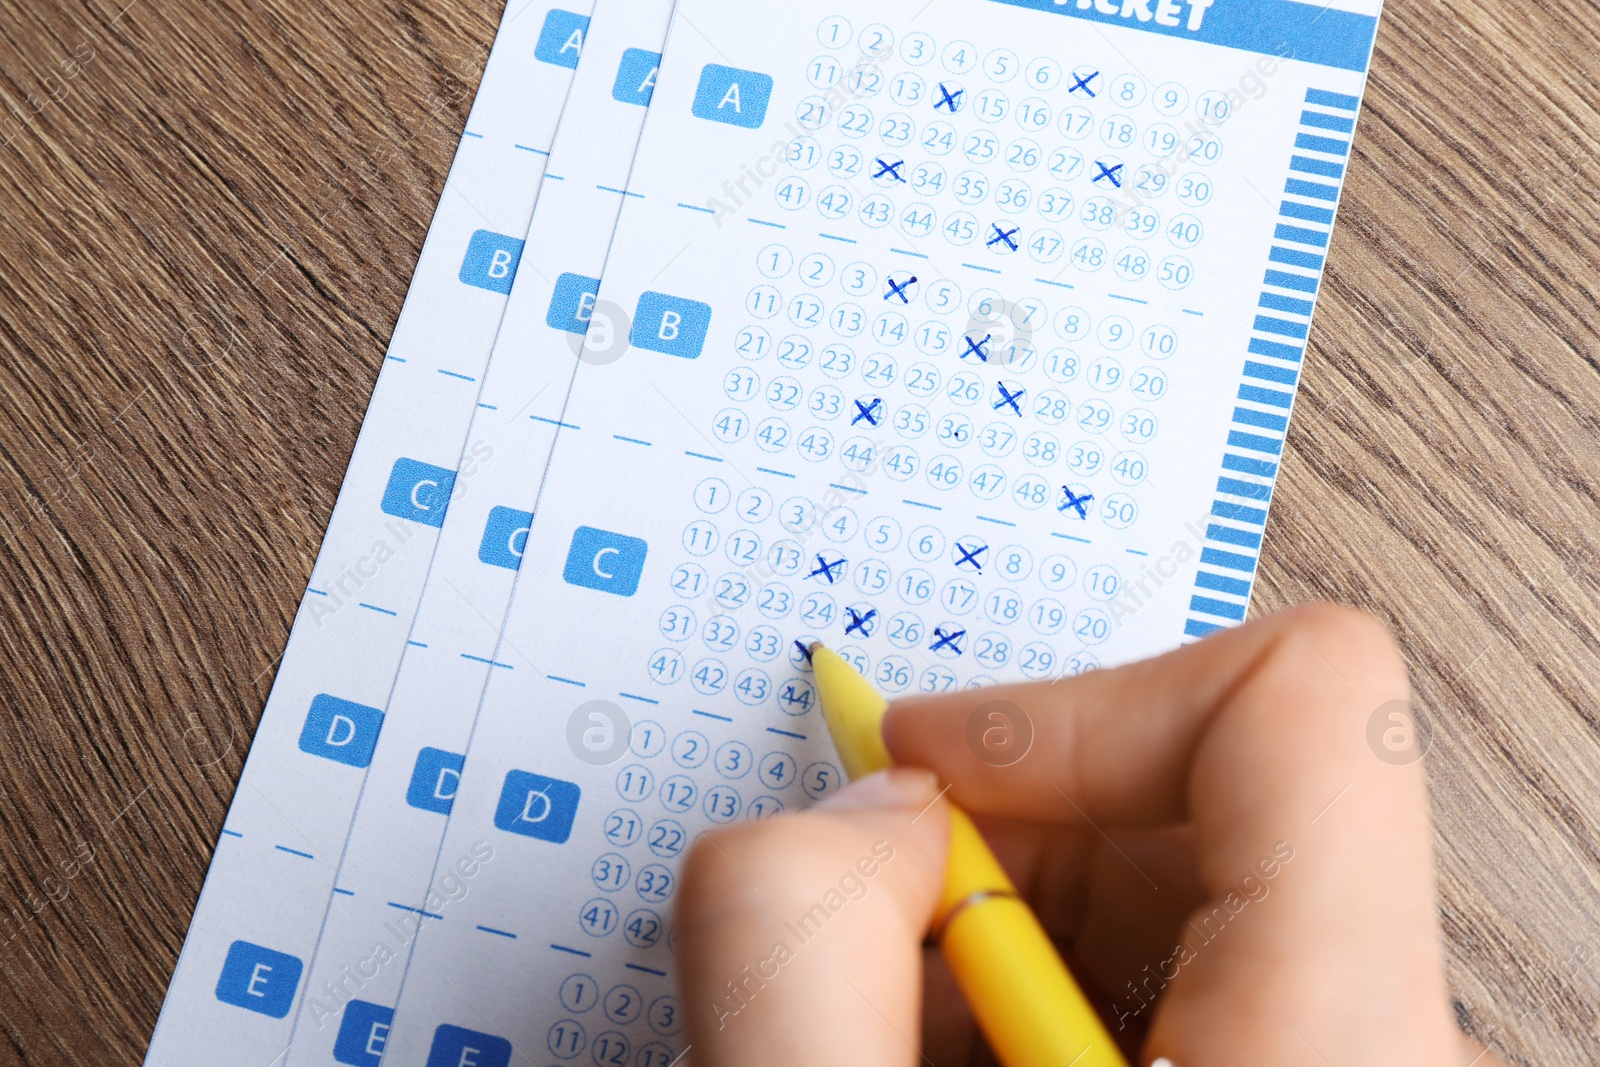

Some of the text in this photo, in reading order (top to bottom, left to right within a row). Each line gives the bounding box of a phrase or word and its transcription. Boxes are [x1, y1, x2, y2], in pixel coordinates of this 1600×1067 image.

[560, 29, 583, 56] A
[910, 39, 925, 60] 3
[951, 48, 966, 67] 4
[993, 55, 1009, 76] 5
[1120, 81, 1136, 101] 8
[1163, 89, 1179, 109] 9
[717, 83, 741, 113] A
[814, 62, 836, 84] 11
[897, 79, 921, 101] 13
[981, 95, 1006, 118] 15
[1023, 104, 1048, 127] 16
[1065, 112, 1091, 134] 17
[1107, 121, 1134, 144] 18
[882, 119, 911, 141] 23
[924, 127, 953, 149] 24
[966, 135, 996, 159] 25
[1009, 144, 1037, 167] 26
[1051, 153, 1081, 175] 27
[1180, 178, 1210, 202] 30
[831, 150, 860, 174] 32
[914, 167, 943, 191] 34
[957, 176, 986, 199] 35
[998, 185, 1028, 208] 36
[1041, 193, 1071, 216] 37
[1169, 221, 1200, 243] 40
[777, 183, 804, 205] 41
[820, 192, 849, 215] 42
[861, 201, 891, 223] 43
[903, 210, 933, 231] 44
[945, 218, 976, 240] 45
[1031, 235, 1061, 257] 47
[1073, 244, 1104, 267] 48
[1116, 254, 1147, 276] 48
[1161, 261, 1191, 285] 50
[487, 249, 512, 278] B
[575, 291, 597, 322] B
[657, 310, 681, 341] B
[808, 260, 825, 281] 2
[850, 269, 866, 290] 3
[936, 287, 951, 307] 5
[1063, 314, 1081, 335] 8
[1149, 331, 1175, 354] 10
[753, 291, 776, 313] 11
[795, 300, 821, 323] 12
[837, 309, 862, 332] 13
[880, 318, 905, 342] 14
[923, 327, 948, 350] 15
[1051, 354, 1077, 378] 18
[1134, 372, 1165, 396] 20
[738, 331, 765, 355] 21
[780, 341, 810, 365] 22
[823, 349, 852, 373] 23
[865, 359, 894, 382] 24
[908, 368, 937, 392] 25
[950, 377, 979, 401] 26
[1037, 395, 1067, 420] 28
[1080, 405, 1111, 428] 29
[1126, 414, 1155, 439] 30
[727, 372, 754, 396] 31
[769, 381, 799, 407] 32
[812, 391, 841, 415] 33
[897, 409, 927, 433] 35
[983, 429, 1014, 451] 37
[1027, 437, 1057, 462] 38
[1113, 458, 1145, 481] 40
[716, 415, 743, 437] 41
[758, 424, 788, 448] 42
[800, 433, 830, 457] 43
[929, 462, 959, 485] 46
[972, 471, 1004, 493] 47
[1015, 481, 1047, 504] 48
[1103, 499, 1135, 523] 50
[410, 479, 437, 511] C
[592, 547, 620, 579] C
[746, 495, 763, 517] 2
[832, 515, 847, 536] 4
[874, 524, 891, 545] 5
[918, 535, 934, 555] 6
[1005, 553, 1022, 575] 8
[1092, 571, 1118, 596] 10
[690, 527, 713, 551] 11
[733, 536, 759, 561] 12
[862, 566, 887, 590] 15
[905, 575, 931, 600] 16
[993, 595, 1019, 620] 18
[1077, 615, 1108, 639] 20
[674, 568, 702, 593] 21
[760, 588, 791, 614] 23
[803, 598, 833, 623] 24
[890, 618, 921, 643] 26
[977, 638, 1009, 663] 28
[1022, 648, 1053, 672] 29
[663, 611, 691, 635] 31
[706, 621, 737, 647] 32
[749, 631, 779, 657] 33
[879, 661, 909, 687] 36
[651, 656, 767, 700] 41 42 43
[325, 715, 356, 747] D
[433, 767, 461, 800] D
[681, 739, 699, 761] 2
[725, 749, 742, 771] 3
[768, 761, 785, 781] 4
[812, 770, 829, 793] 5
[522, 789, 551, 823] D
[624, 771, 648, 796] 11
[668, 782, 694, 808] 12
[711, 792, 738, 818] 13
[606, 815, 683, 852] 21 22
[595, 859, 670, 897] 31 32
[583, 906, 658, 943] 41 42
[246, 963, 273, 997] E
[614, 993, 632, 1018] 2
[658, 1004, 676, 1029] 3
[365, 1022, 390, 1056] E
[555, 1026, 627, 1065] 11 12
